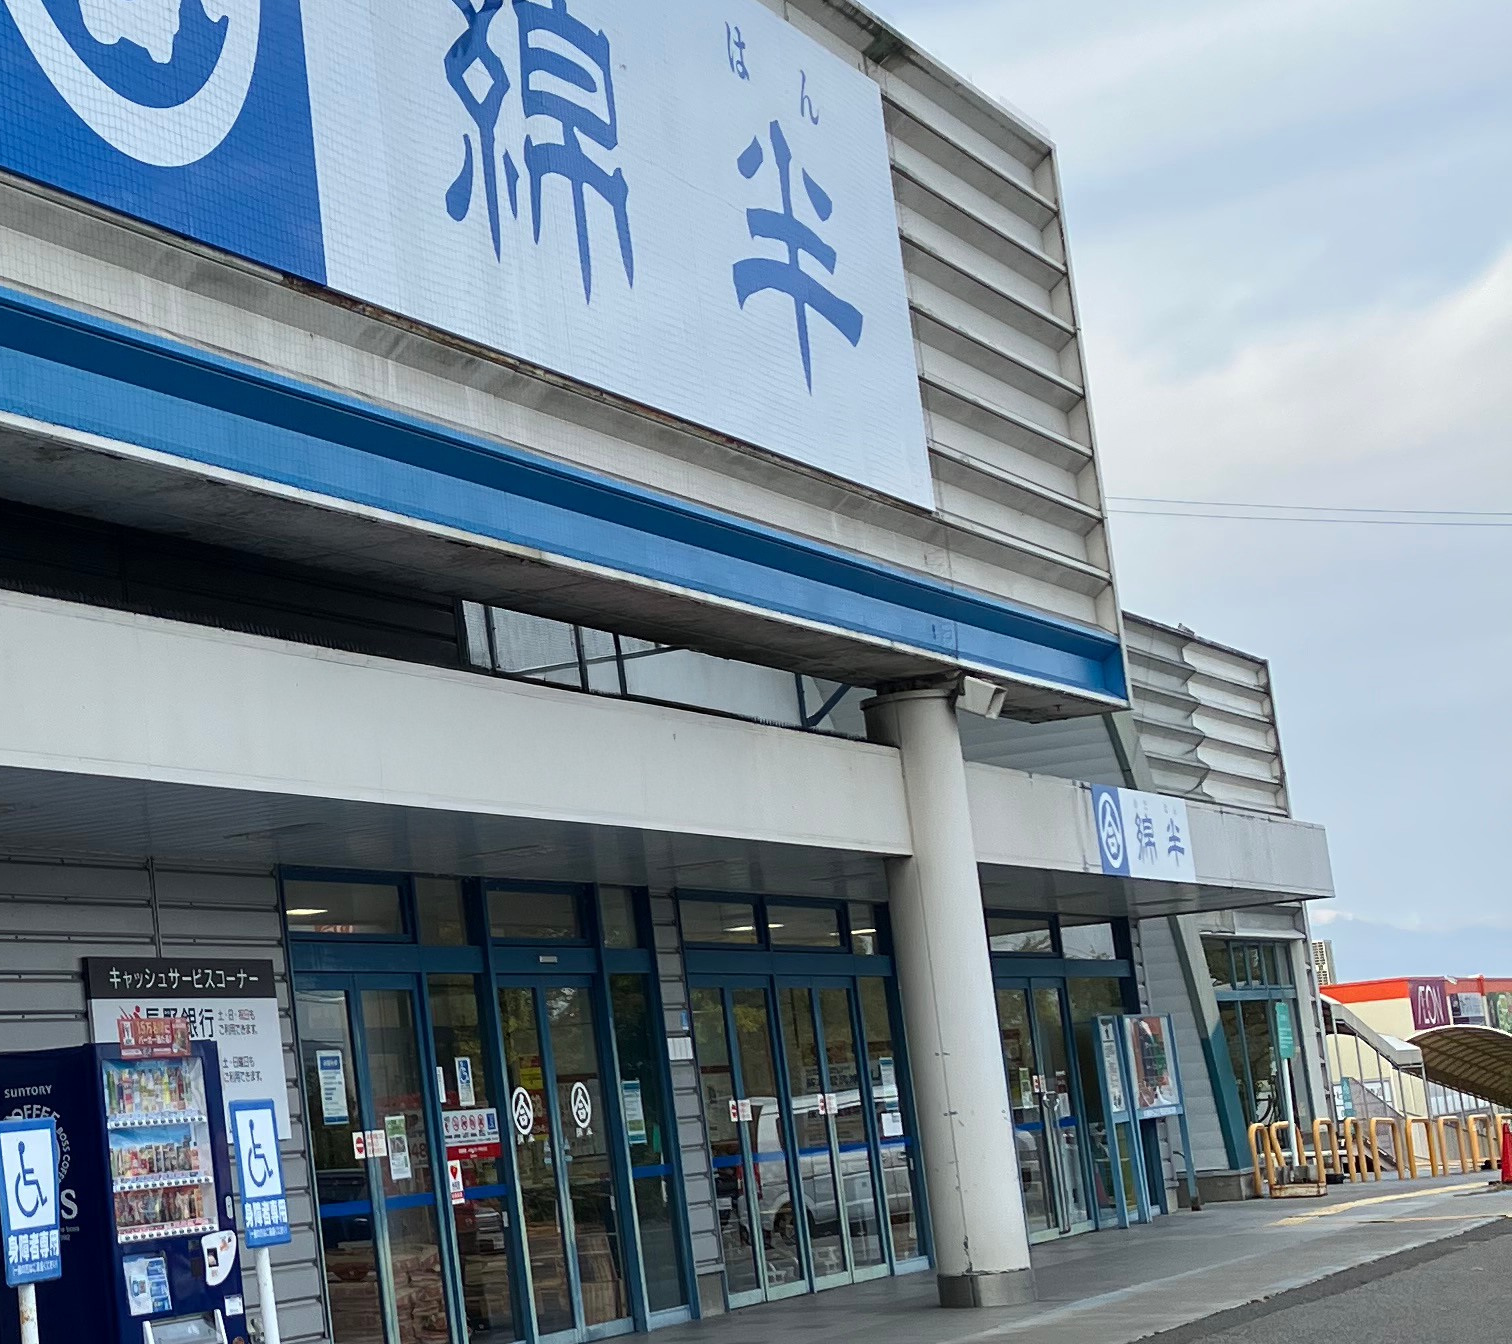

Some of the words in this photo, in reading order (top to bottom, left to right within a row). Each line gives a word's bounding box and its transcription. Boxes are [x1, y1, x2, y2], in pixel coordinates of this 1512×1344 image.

[109, 967, 259, 990] キャッシュサービスコーナー
